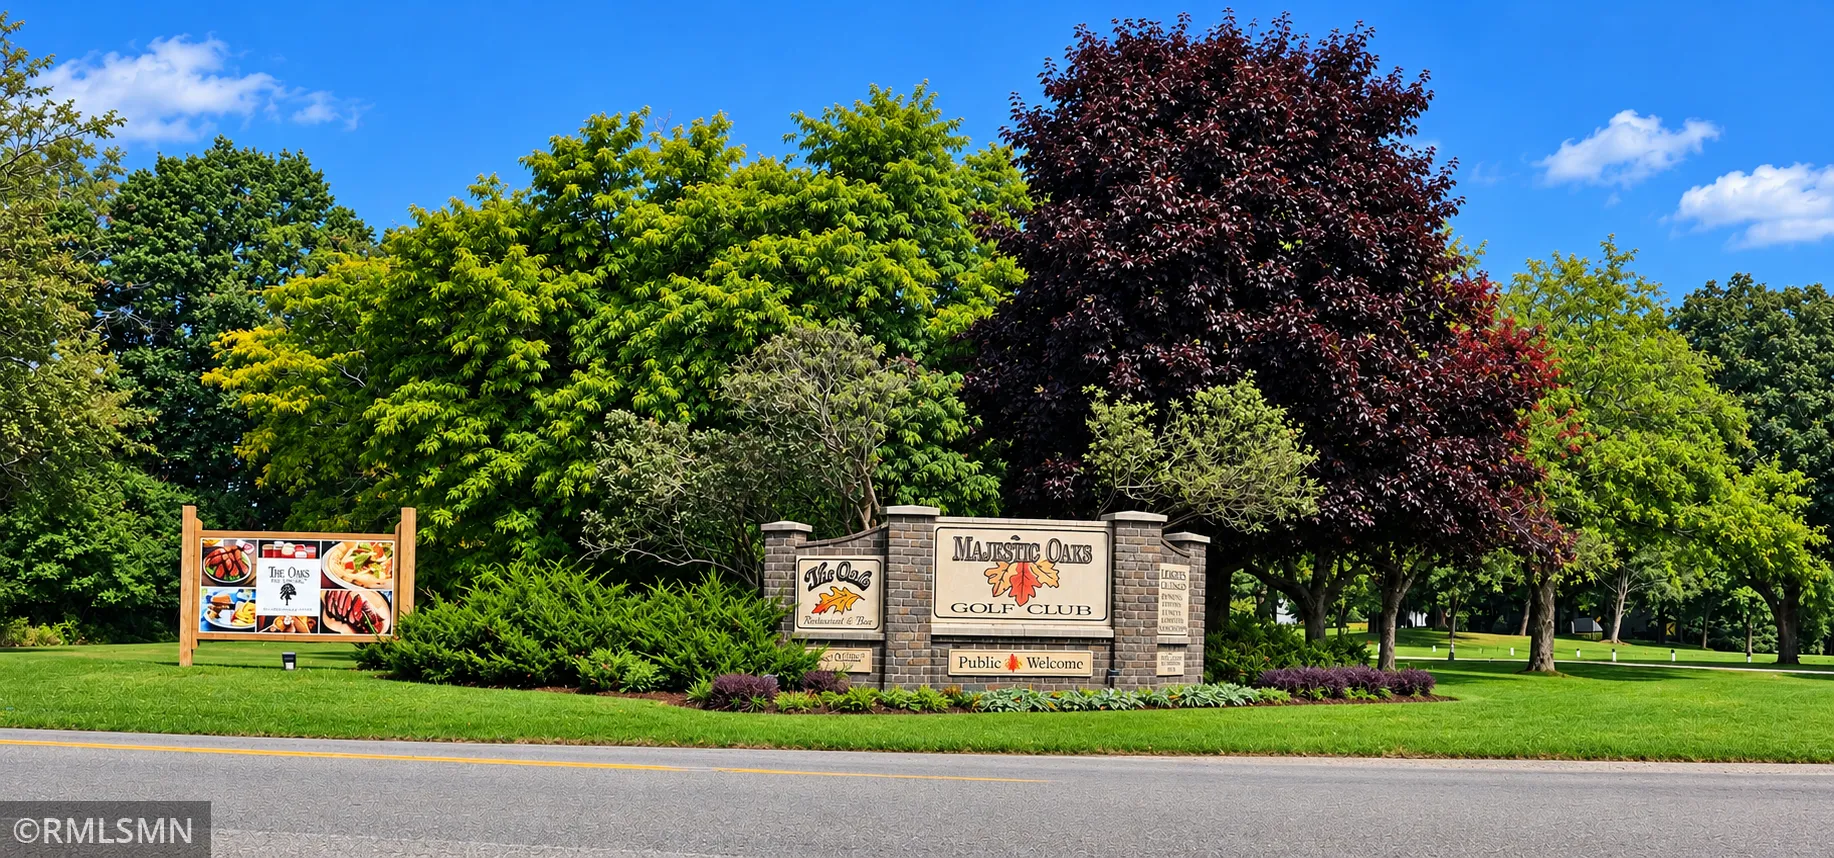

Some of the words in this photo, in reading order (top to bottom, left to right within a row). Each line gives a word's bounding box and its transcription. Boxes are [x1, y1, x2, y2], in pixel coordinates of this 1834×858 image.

[952, 536, 1040, 563] MAJESTIC
[1046, 538, 1093, 564] OAKS
[950, 603, 1015, 614] GOLF
[1027, 604, 1092, 615] CLUB
[958, 656, 1001, 669] Public
[1026, 656, 1084, 670] Welcome
